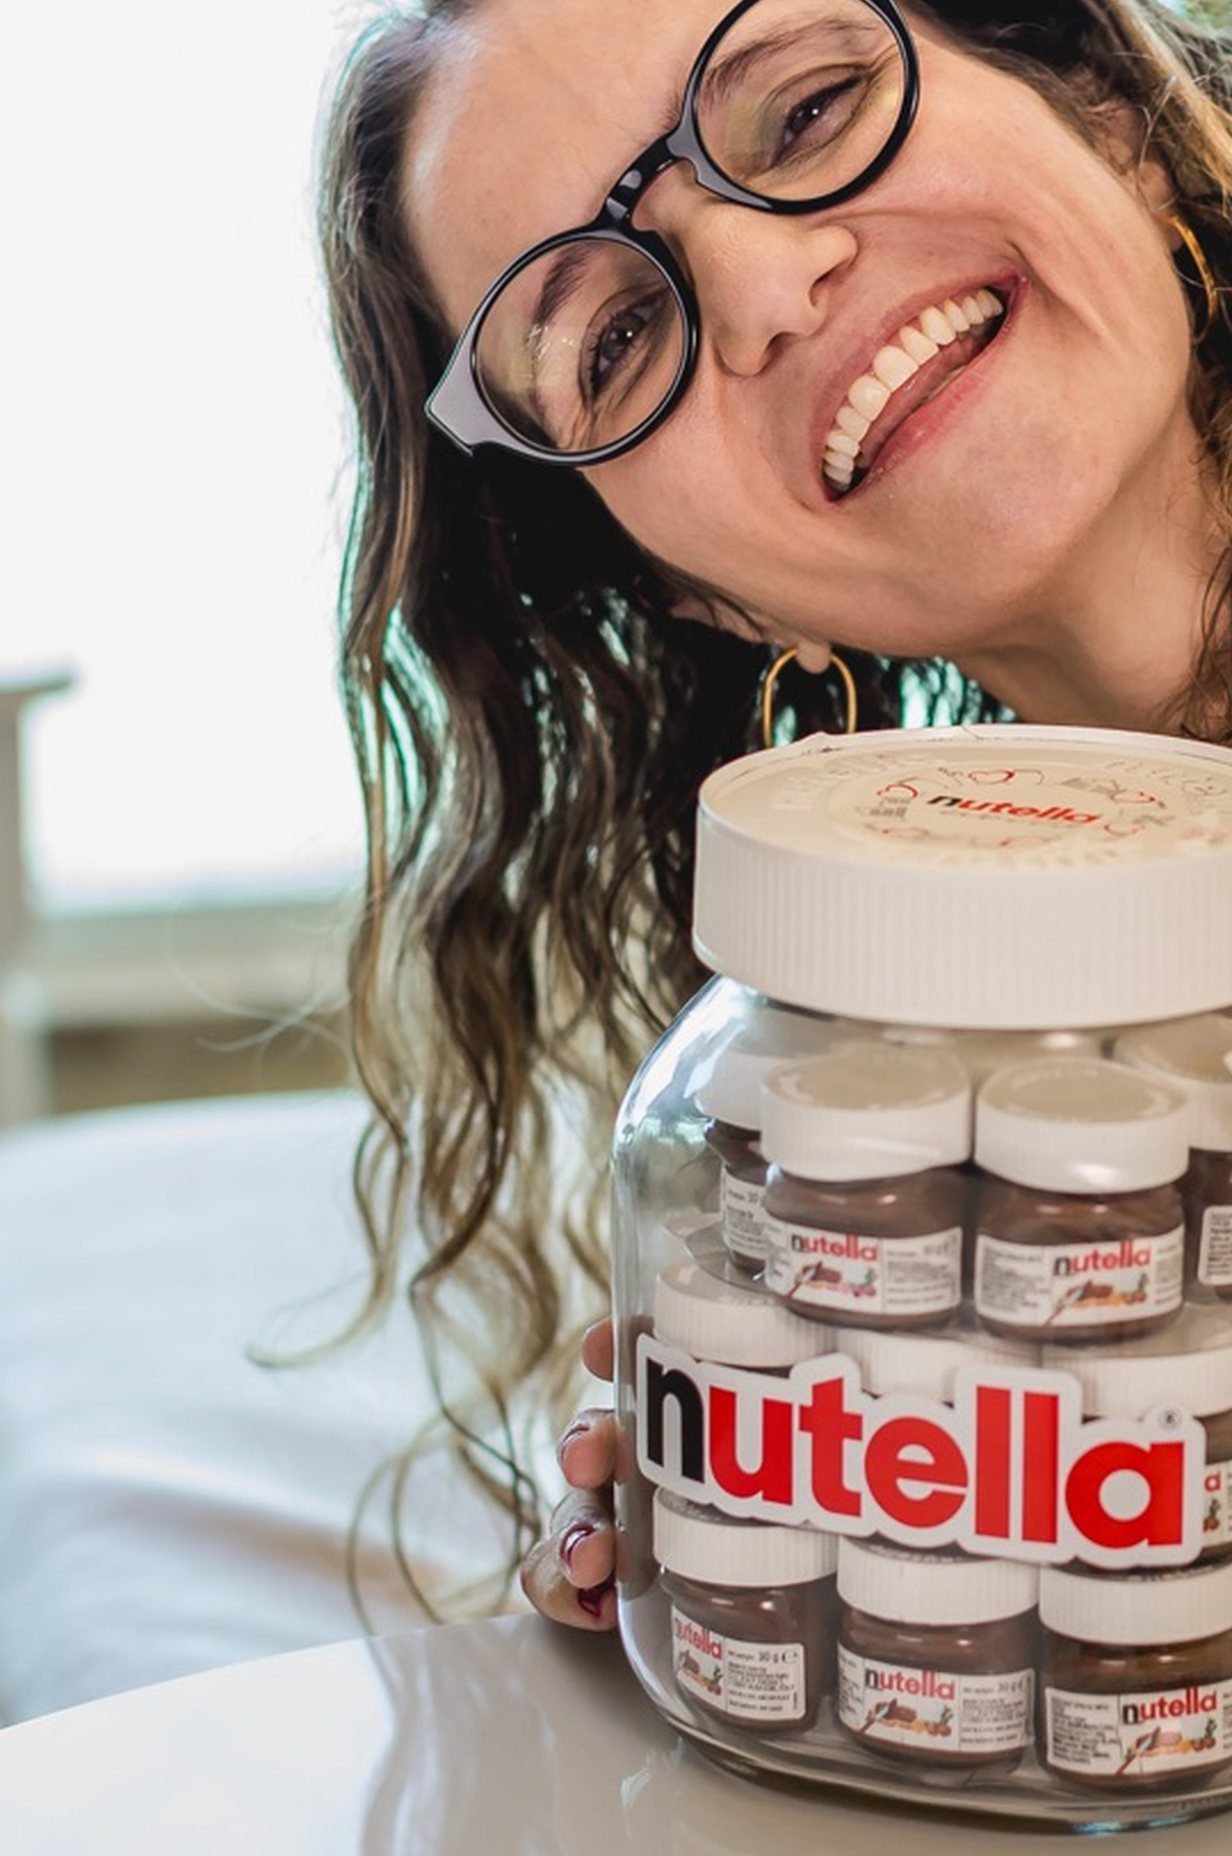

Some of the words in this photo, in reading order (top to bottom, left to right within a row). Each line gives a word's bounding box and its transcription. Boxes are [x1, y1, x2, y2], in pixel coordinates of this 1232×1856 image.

[927, 795, 1099, 823] nutella
[791, 1232, 878, 1261] nutella
[1053, 1240, 1150, 1276] nutella
[646, 1356, 1184, 1549] nutella
[865, 1667, 956, 1700] nutella
[1122, 1687, 1217, 1725] nutella
